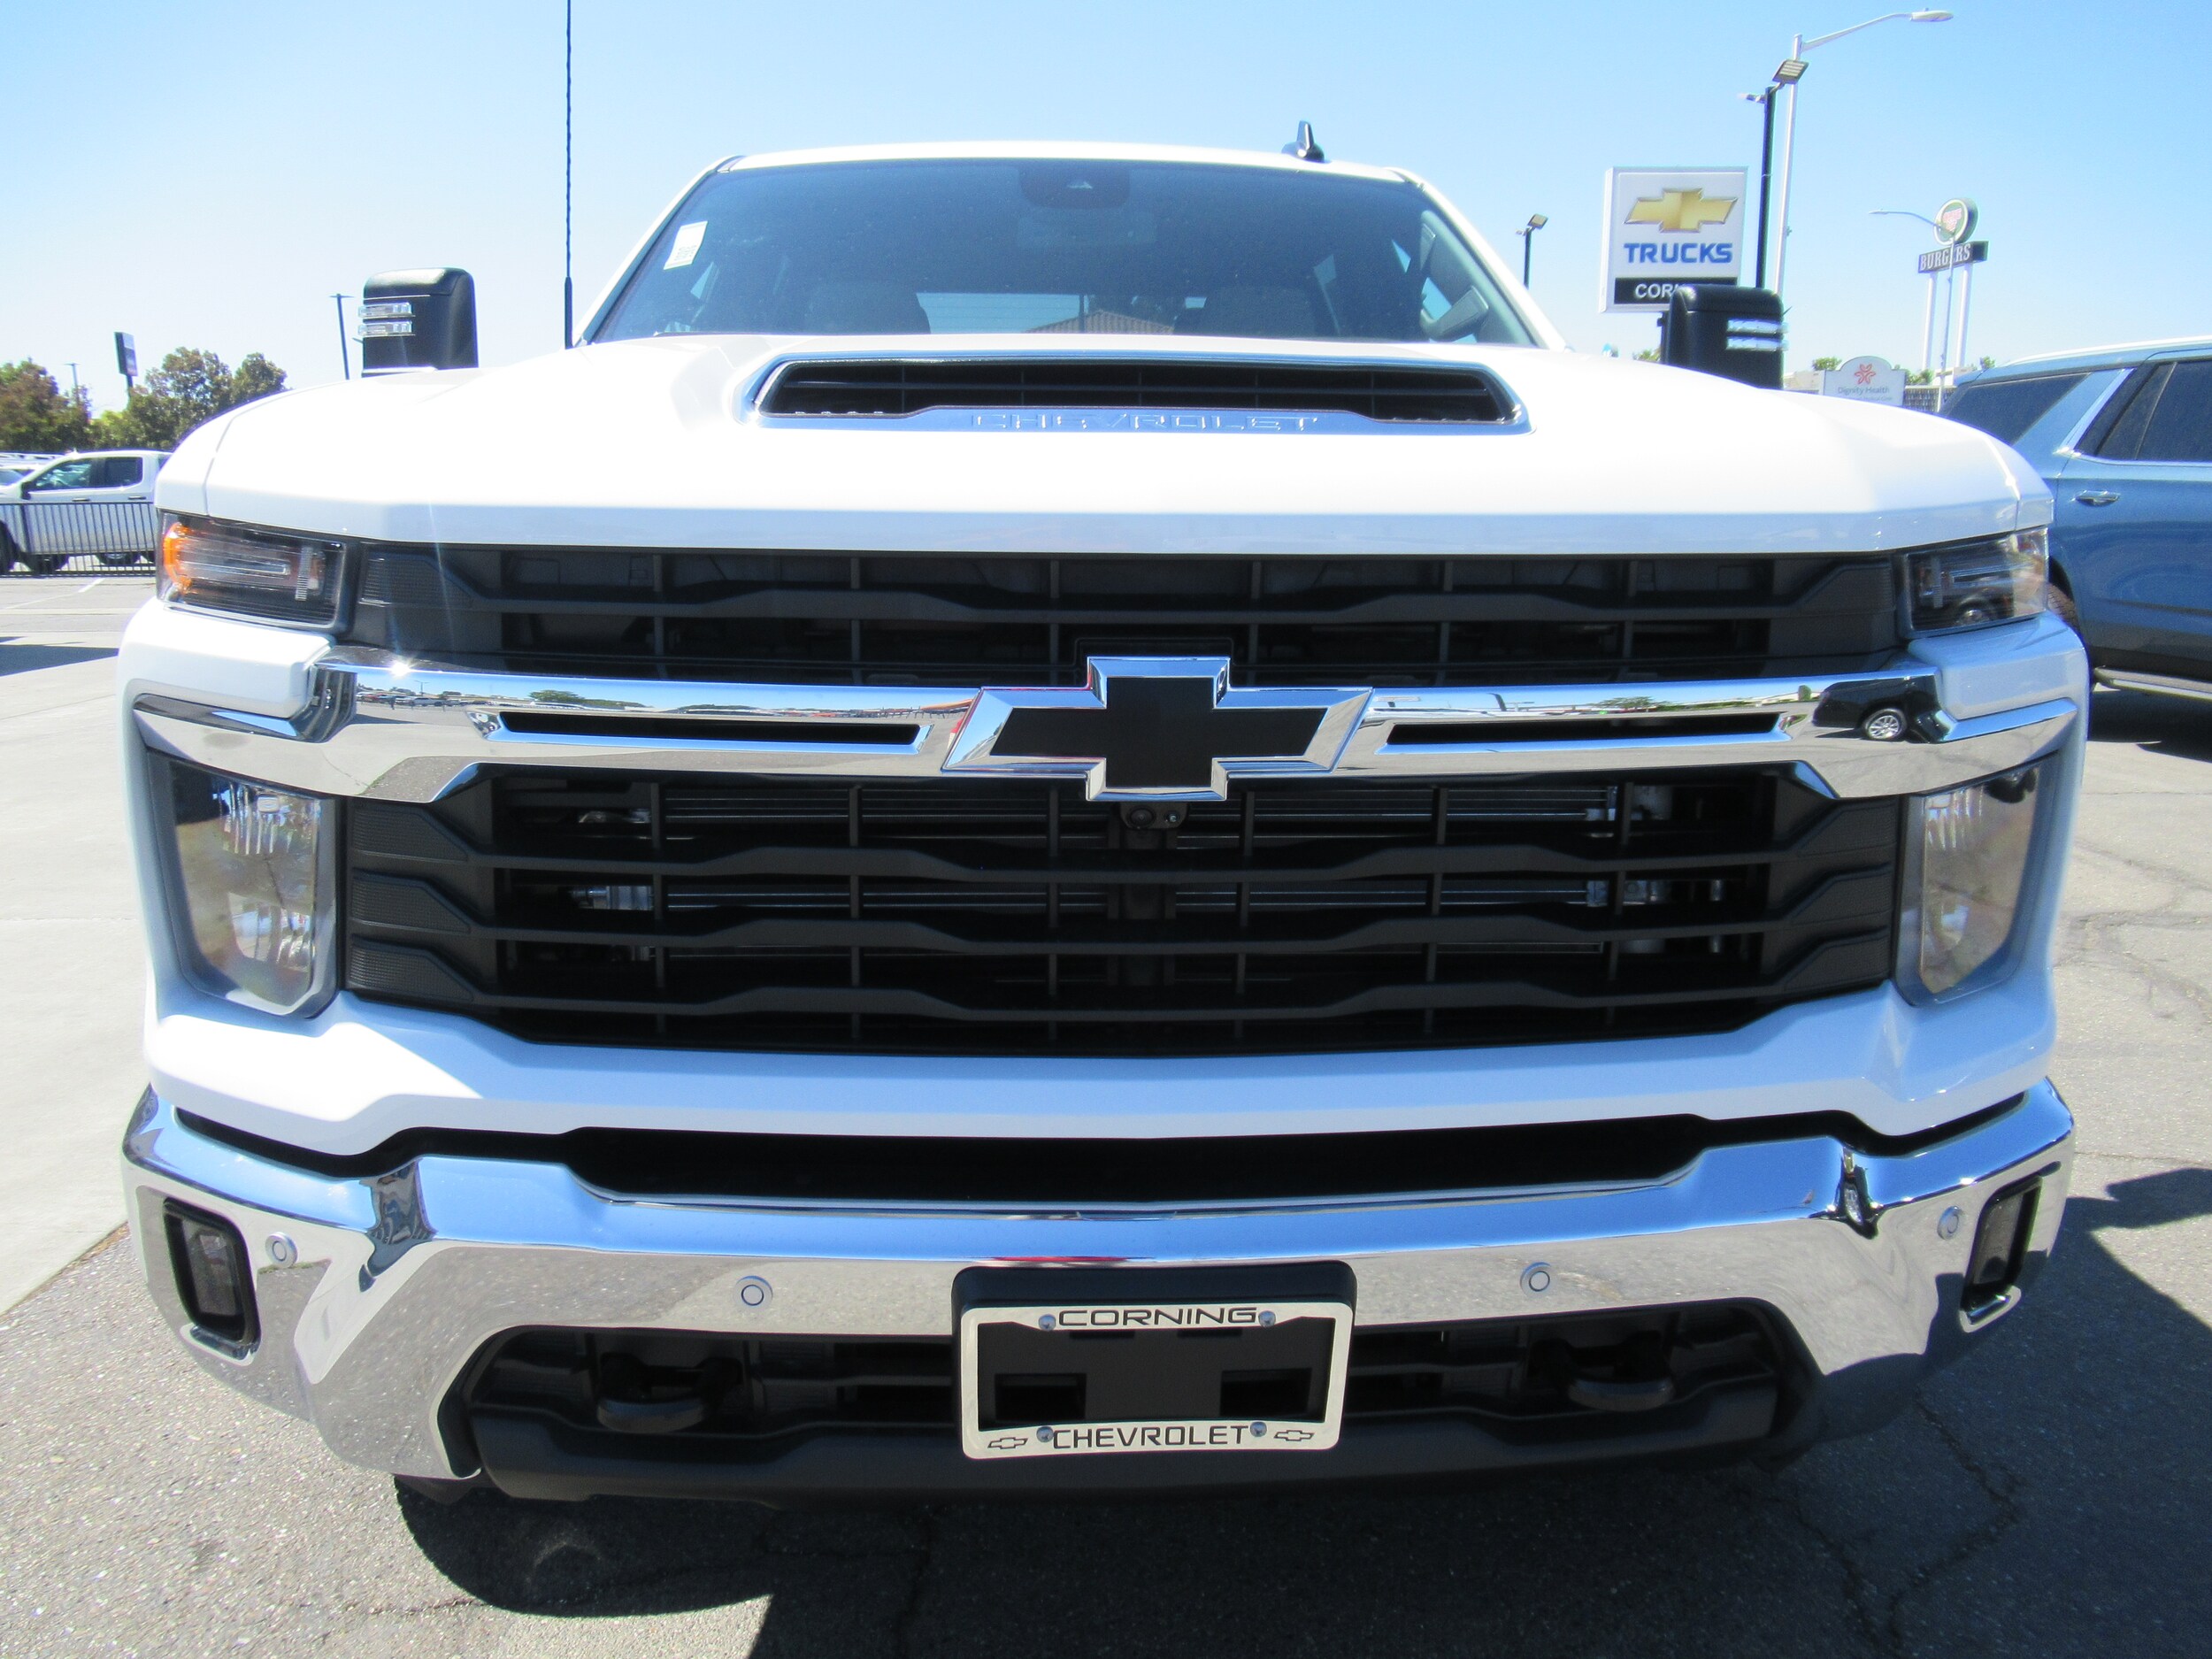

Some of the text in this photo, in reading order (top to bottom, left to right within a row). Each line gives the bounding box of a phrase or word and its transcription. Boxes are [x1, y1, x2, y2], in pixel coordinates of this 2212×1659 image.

[1624, 242, 1733, 264] TRUCKS
[1920, 243, 1970, 271] BURGRS
[1635, 283, 1679, 299] COR
[1838, 385, 1890, 396] Dignity Health
[972, 413, 1318, 430] CHEVROLET
[1058, 1307, 1257, 1326] CORNING
[1052, 1425, 1249, 1450] CHEVROLET
